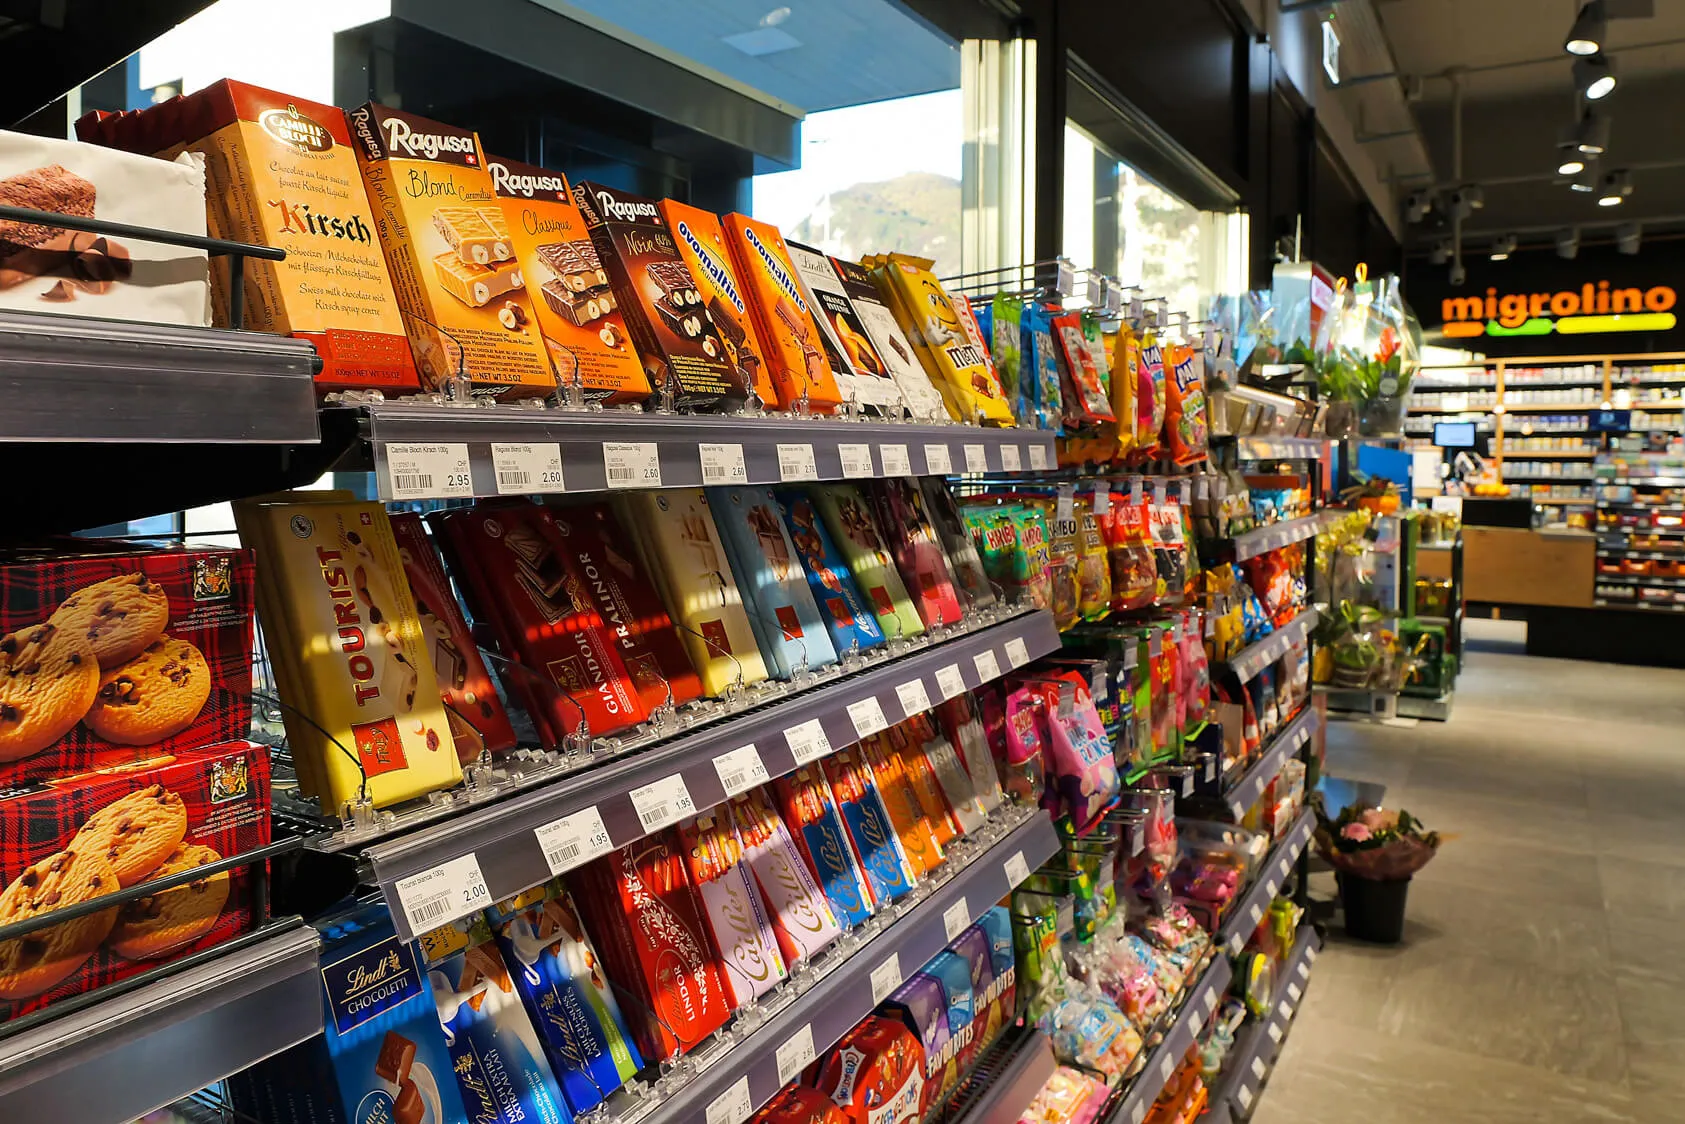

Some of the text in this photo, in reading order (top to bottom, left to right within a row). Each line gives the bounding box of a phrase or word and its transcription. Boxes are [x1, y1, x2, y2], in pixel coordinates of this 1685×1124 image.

[352, 107, 381, 159] Ragusa
[382, 117, 474, 159] Ragusa
[405, 168, 456, 198] Blond
[488, 163, 563, 197] Ragusa
[267, 198, 371, 247] Kirsch
[572, 185, 600, 225] Ragusa
[596, 191, 657, 222] Ragusa
[522, 209, 572, 237] Classique
[623, 231, 661, 256] Noir
[678, 220, 745, 315] ovomaltine
[697, 262, 726, 299] CRUNCHY
[744, 226, 807, 314] ovomaltine
[315, 299, 340, 311] Kirsch
[1441, 279, 1677, 328] migrolino
[479, 372, 491, 380] NET
[493, 373, 502, 381] WT
[447, 474, 470, 486] 2.95
[542, 471, 560, 483] 2.60
[644, 468, 659, 479] 2.60
[732, 467, 745, 476] 2.60
[579, 552, 635, 650] PRALINOR
[316, 545, 380, 707] TOURIST
[574, 631, 618, 715] GIANDOR
[752, 765, 765, 777] 1.70
[675, 797, 691, 811] 1.95
[590, 832, 608, 848] 1.95
[463, 883, 486, 902] 2.00
[723, 883, 768, 982] Cailler
[345, 957, 389, 995] Lindt
[674, 964, 696, 1021] LINDOR
[974, 965, 1016, 1017] FAVOURITES
[347, 977, 408, 1014] CHOCOLETTI
[563, 995, 593, 1056] MILCH-NUSS
[489, 1048, 506, 1071] LAIT
[590, 1037, 602, 1058] LAIT
[926, 1021, 975, 1080] FAVOURITES
[483, 1053, 518, 1124] MILCH EXTRA
[506, 1087, 526, 1121] EXTRA
[737, 1099, 750, 1115] 2.70
